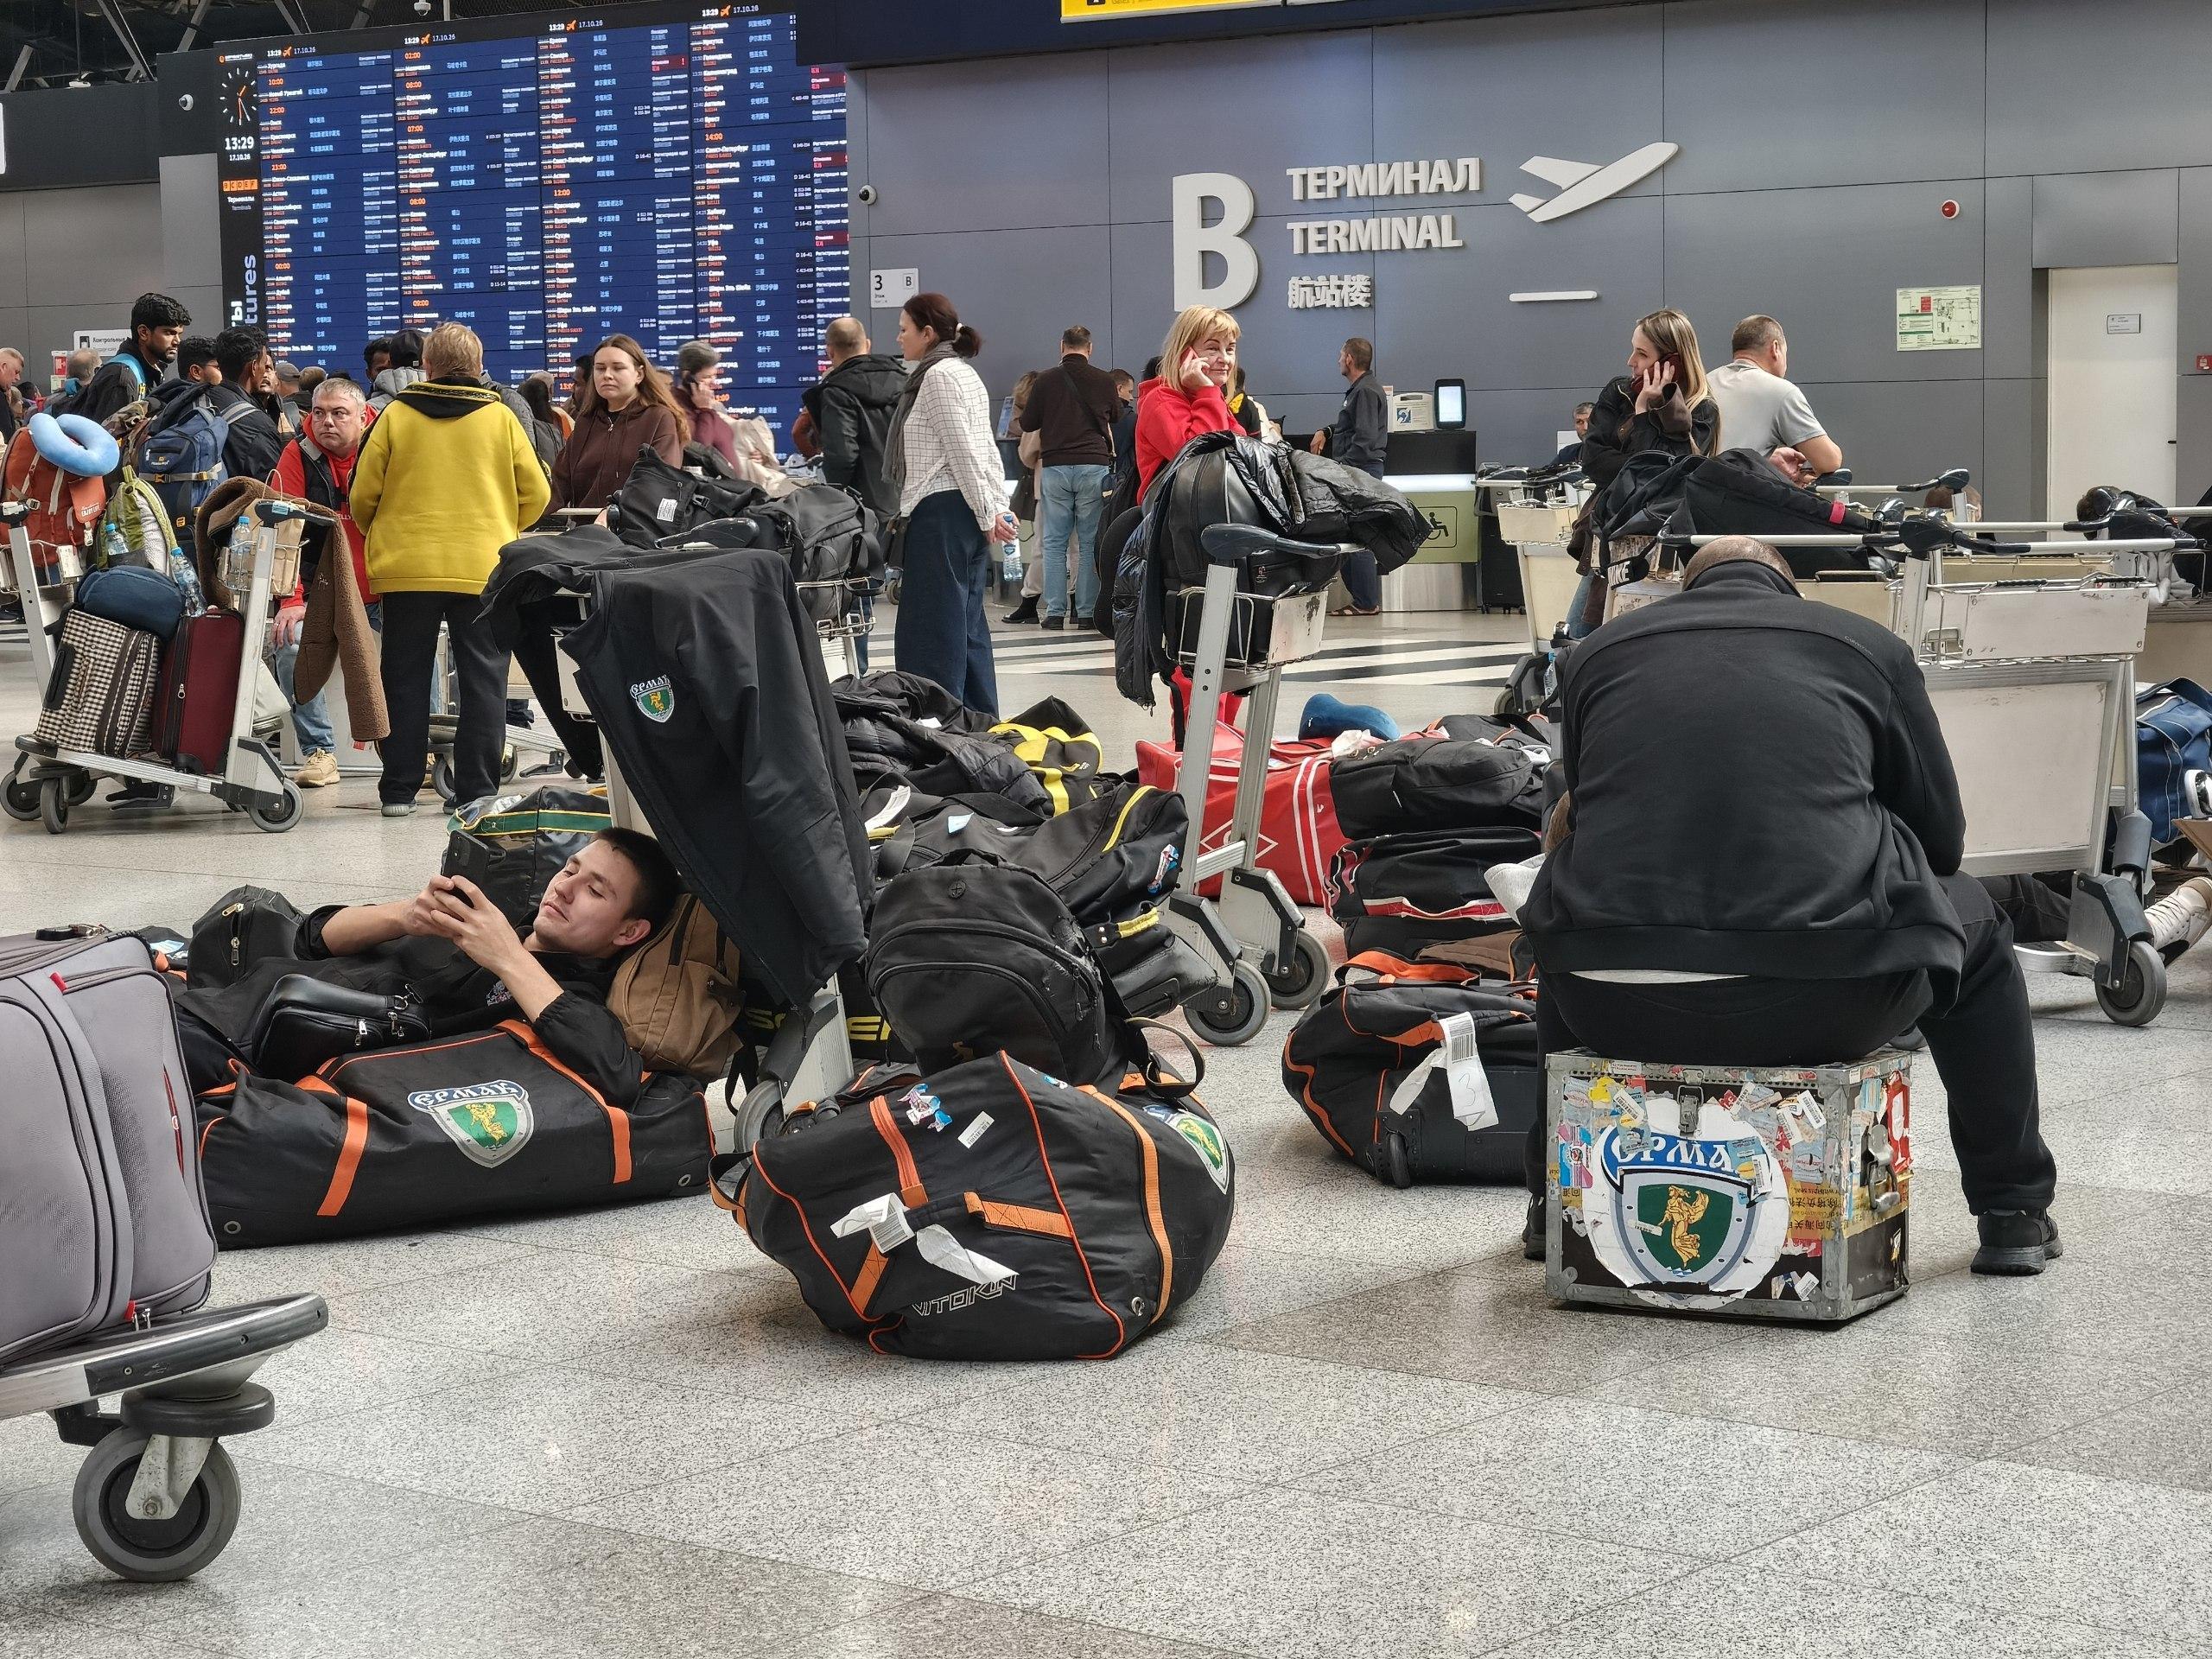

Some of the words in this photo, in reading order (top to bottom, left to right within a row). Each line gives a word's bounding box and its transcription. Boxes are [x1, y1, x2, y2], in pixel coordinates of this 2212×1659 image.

[225, 137, 255, 150] 13:29
[1287, 157, 1480, 200] ТЕРМИНАЛ
[1173, 172, 1259, 312] B
[1287, 214, 1464, 254] TERMINAL
[874, 274, 883, 291] 3
[906, 276, 912, 287] B
[1287, 274, 1372, 309] 航站楼
[1458, 1072, 1477, 1108] 3
[1611, 1135, 1737, 1173] ЕРМА
